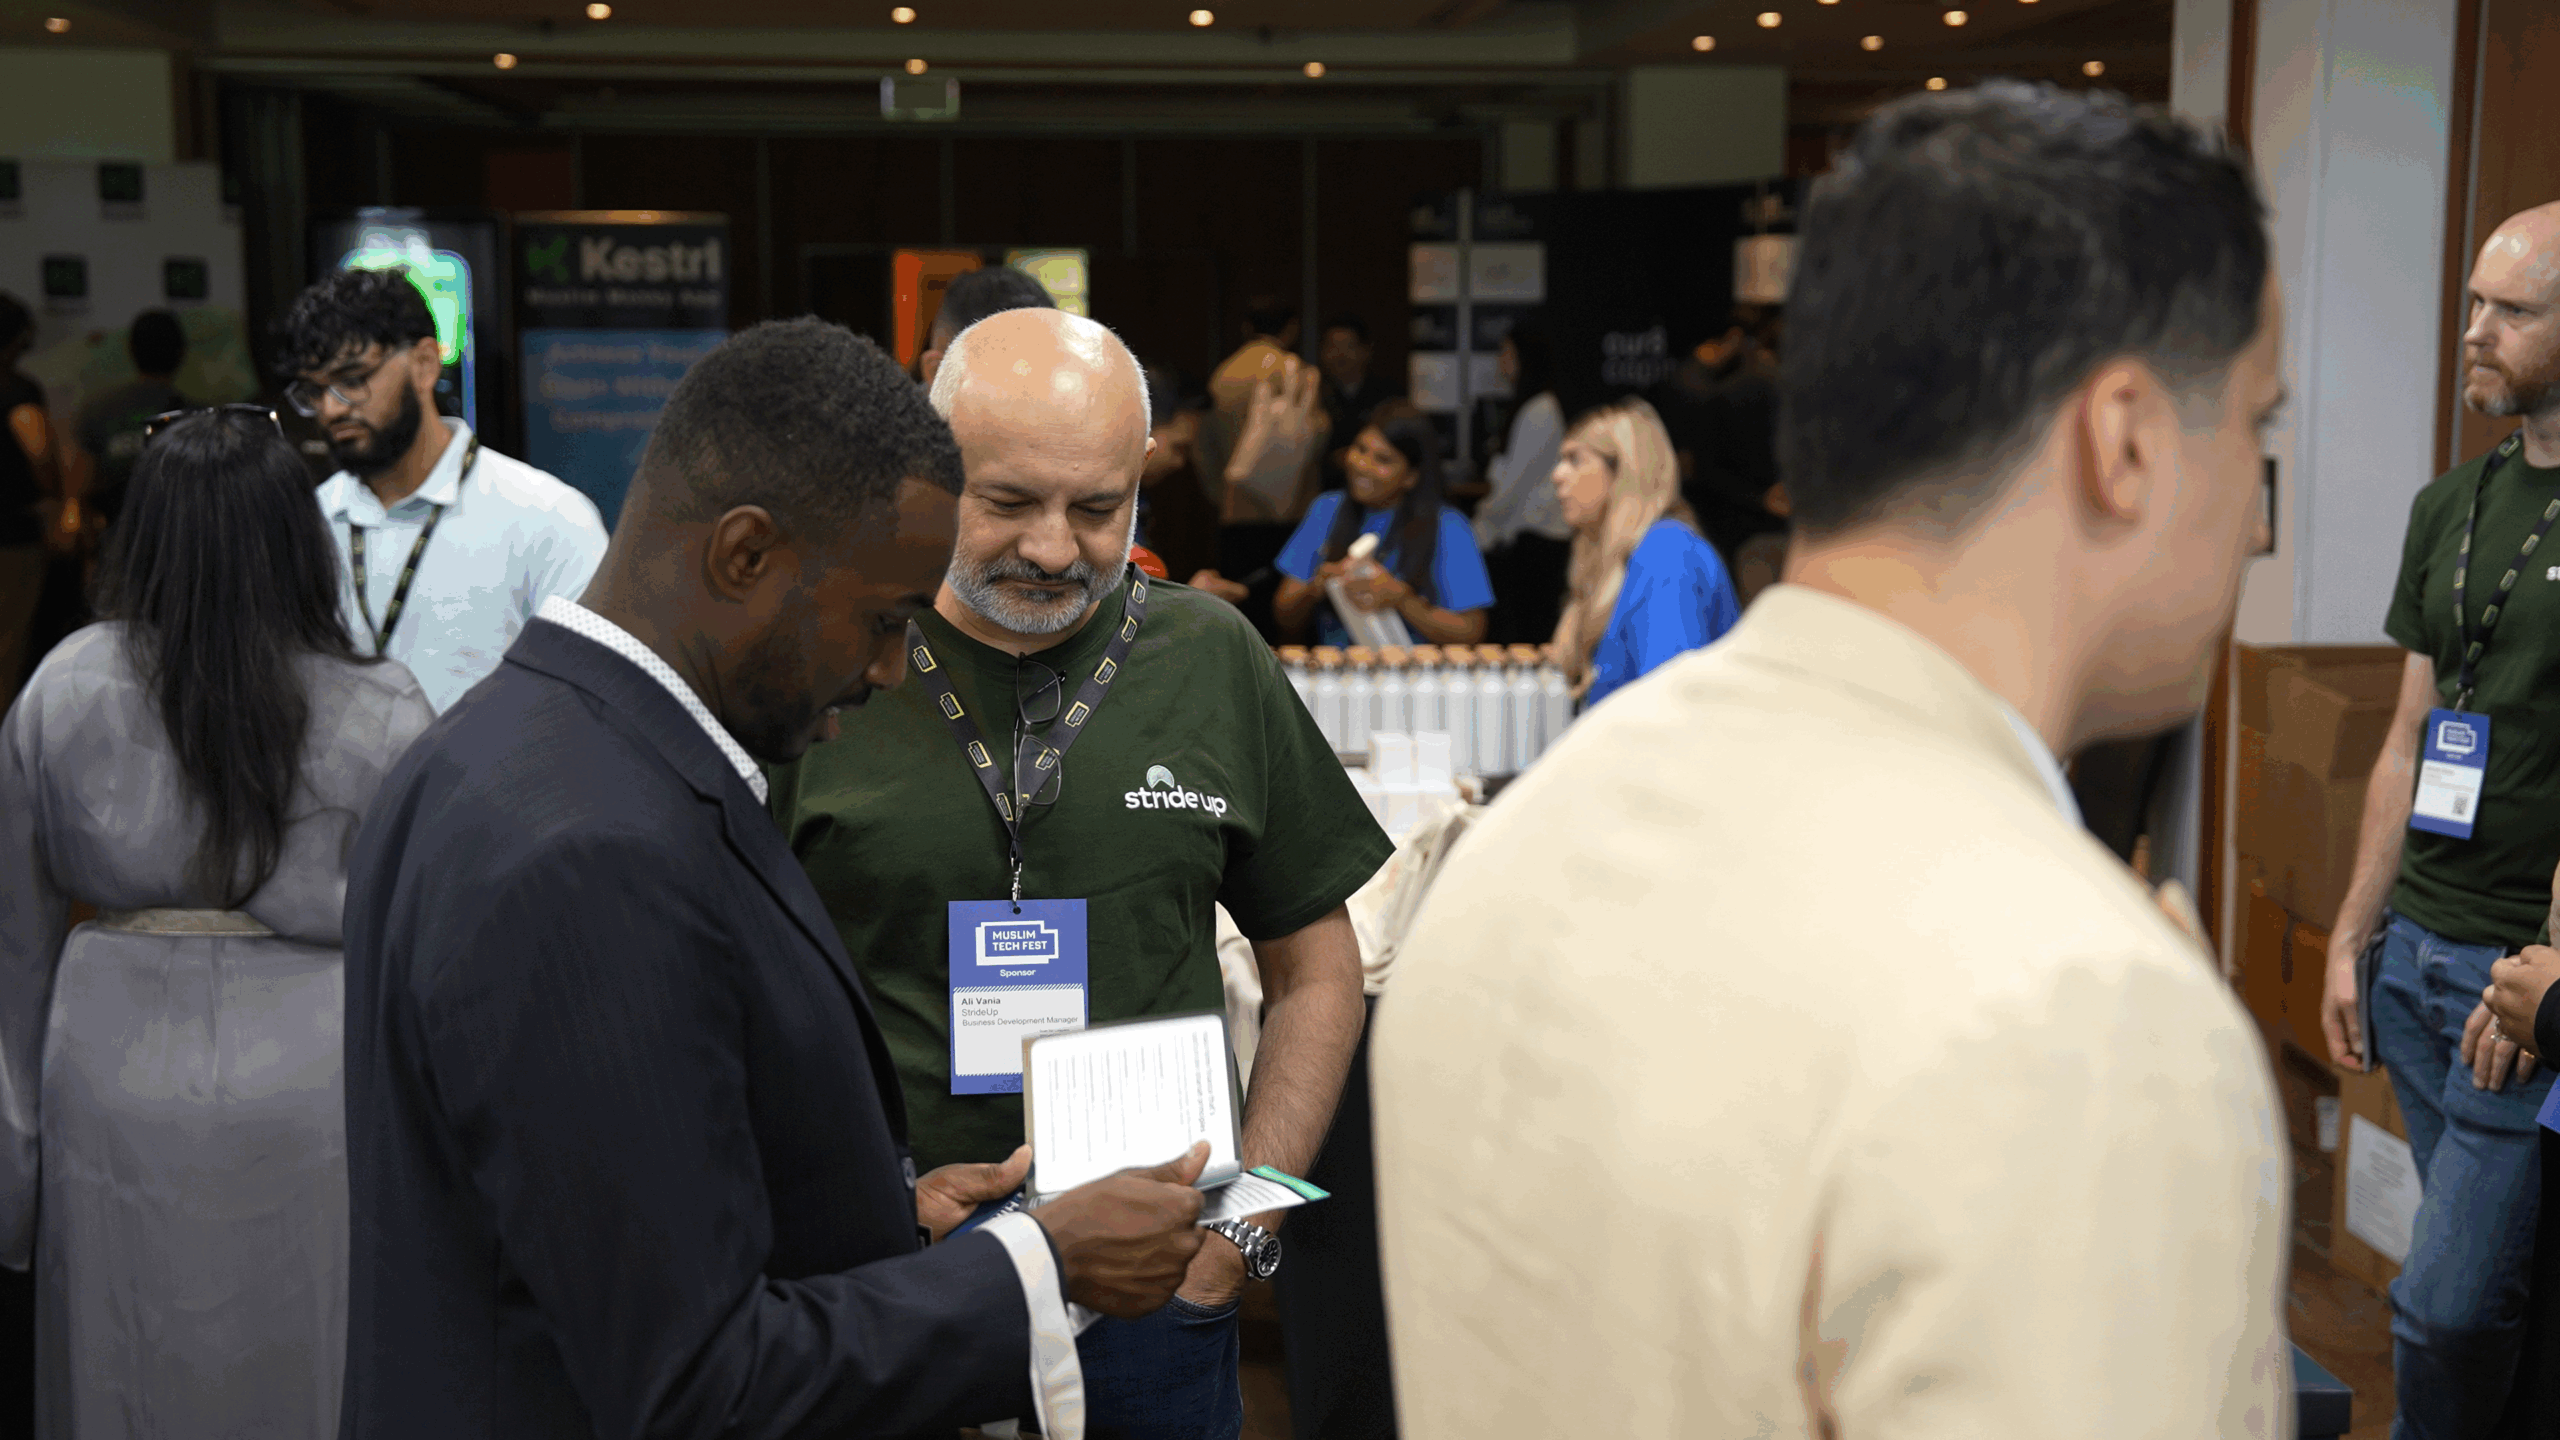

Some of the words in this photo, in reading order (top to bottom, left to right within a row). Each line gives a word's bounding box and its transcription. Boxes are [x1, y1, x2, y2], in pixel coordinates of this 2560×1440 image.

[581, 237, 721, 281] Kestrl
[992, 930, 1036, 940] MUSLIM
[992, 941, 1020, 951] TECH
[1022, 940, 1048, 950] FEST
[1000, 969, 1036, 978] Sponsor
[961, 997, 974, 1005] Ali
[975, 997, 1001, 1005] Vania
[961, 1008, 999, 1017] StrideUp
[997, 1017, 1044, 1026] Development
[1046, 1016, 1078, 1024] Manager
